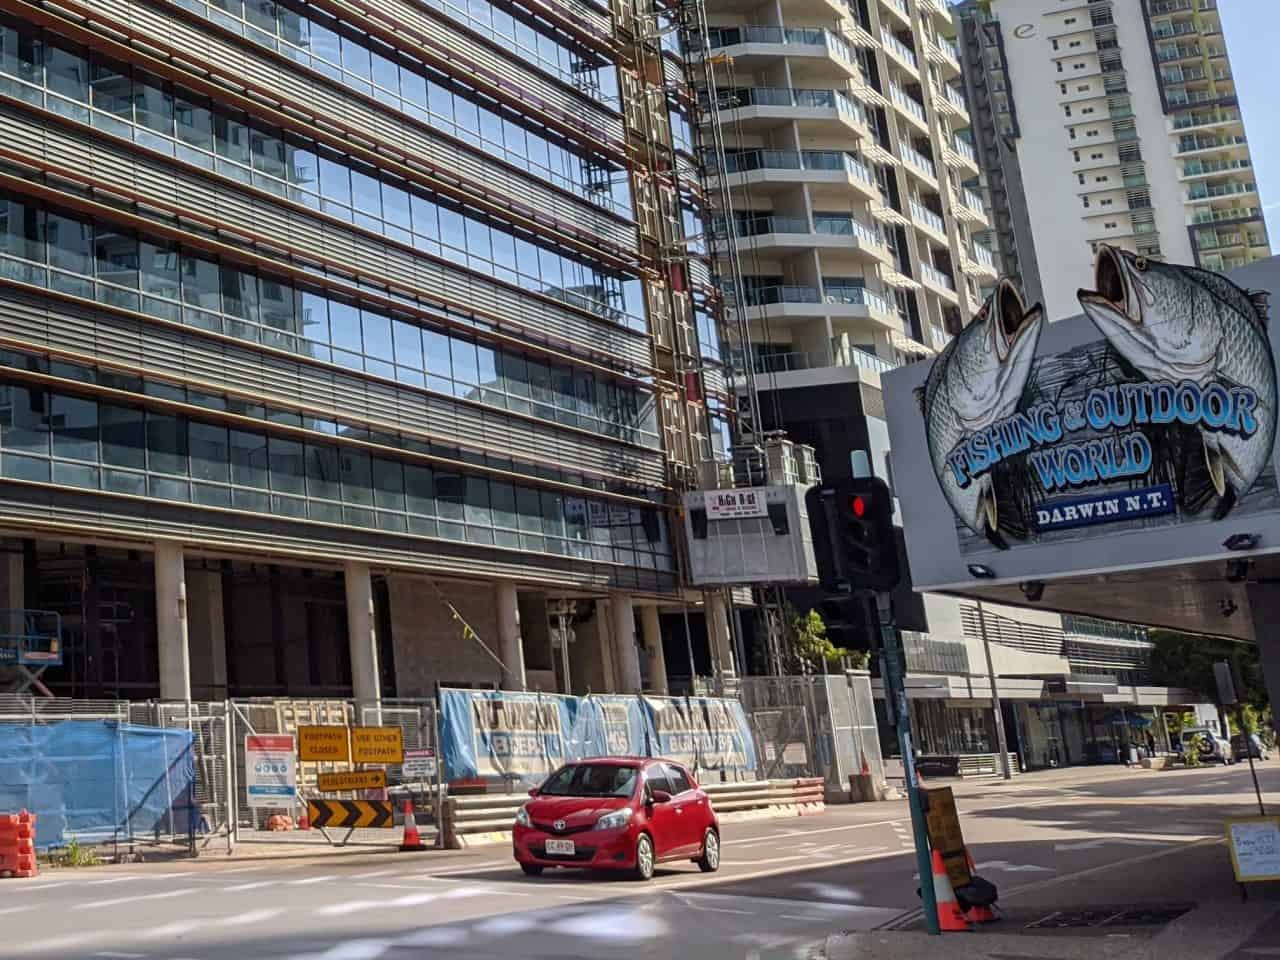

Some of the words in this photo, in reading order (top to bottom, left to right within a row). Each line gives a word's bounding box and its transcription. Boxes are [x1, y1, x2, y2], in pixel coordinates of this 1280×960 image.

[948, 401, 1064, 489] FISHING
[1063, 399, 1087, 431] &
[1086, 379, 1260, 437] OUTDOOR
[1030, 431, 1153, 490] WORLD
[1037, 498, 1119, 526] DARWIN
[1126, 492, 1168, 514] N.T.
[304, 732, 342, 741] FOOTPATH
[310, 745, 338, 753] CLOSED
[359, 747, 396, 757] FOOTPATH
